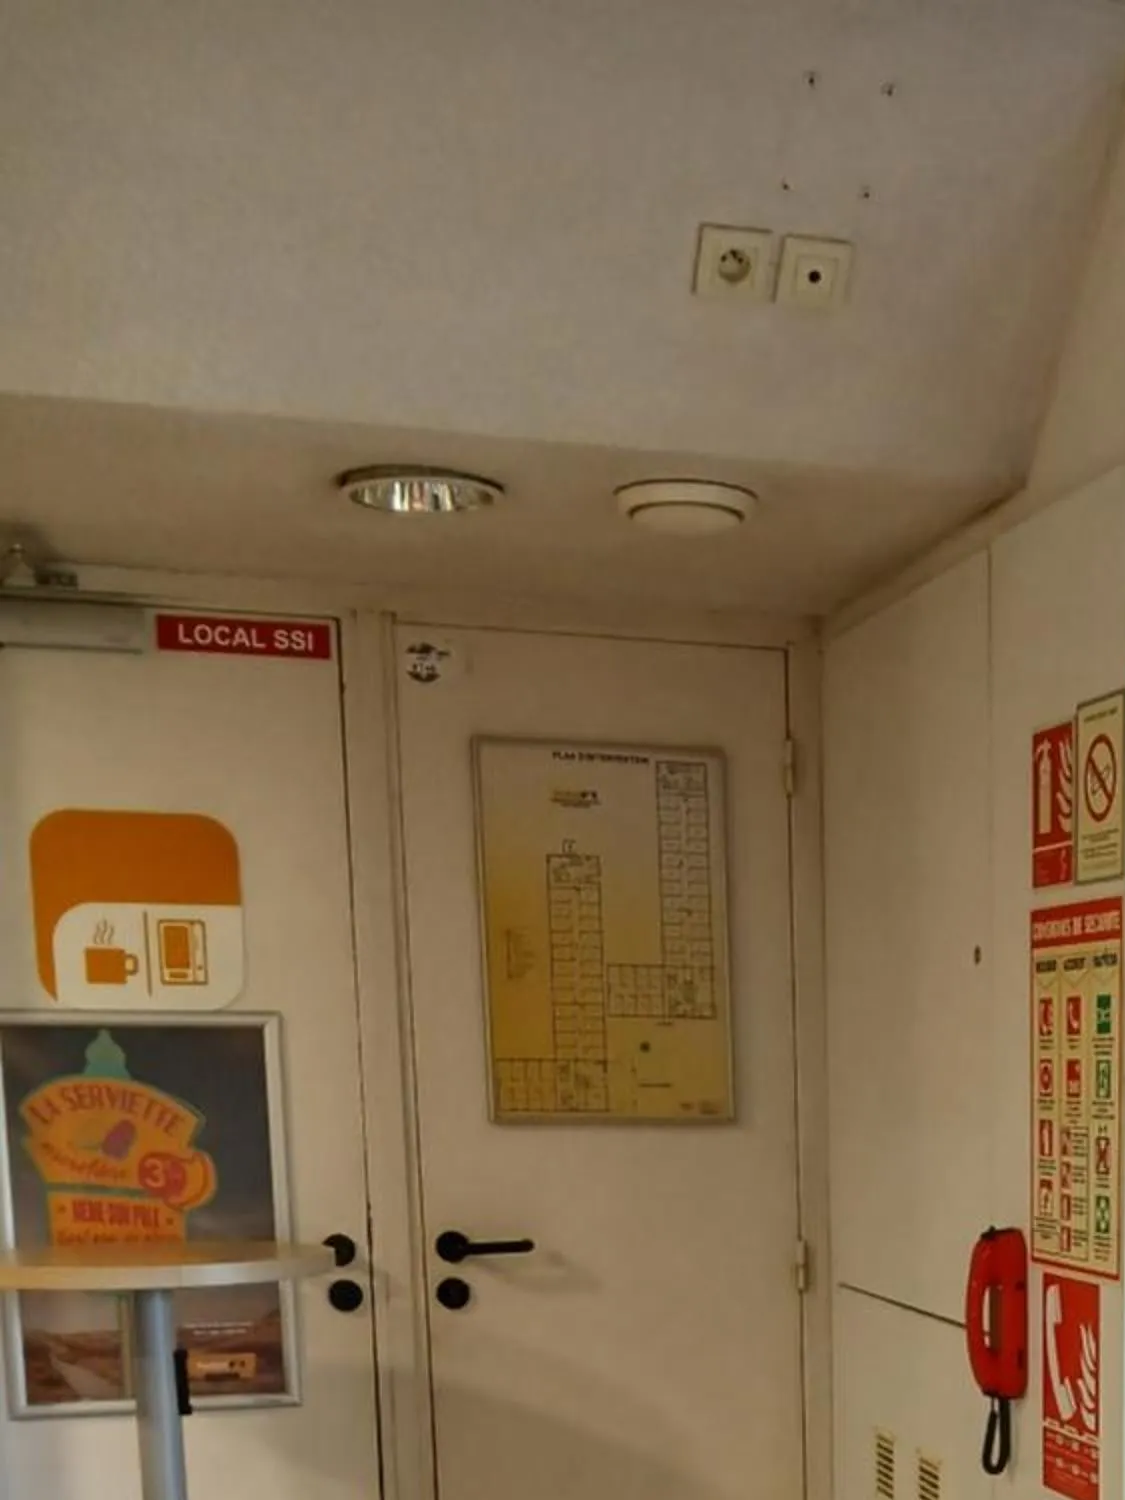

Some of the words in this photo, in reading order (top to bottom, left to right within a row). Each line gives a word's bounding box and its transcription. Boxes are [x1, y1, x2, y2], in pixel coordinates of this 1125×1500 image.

[177, 623, 267, 649] LOCAL
[273, 629, 314, 651] SSI
[60, 1084, 188, 1137] SERVIETTE
